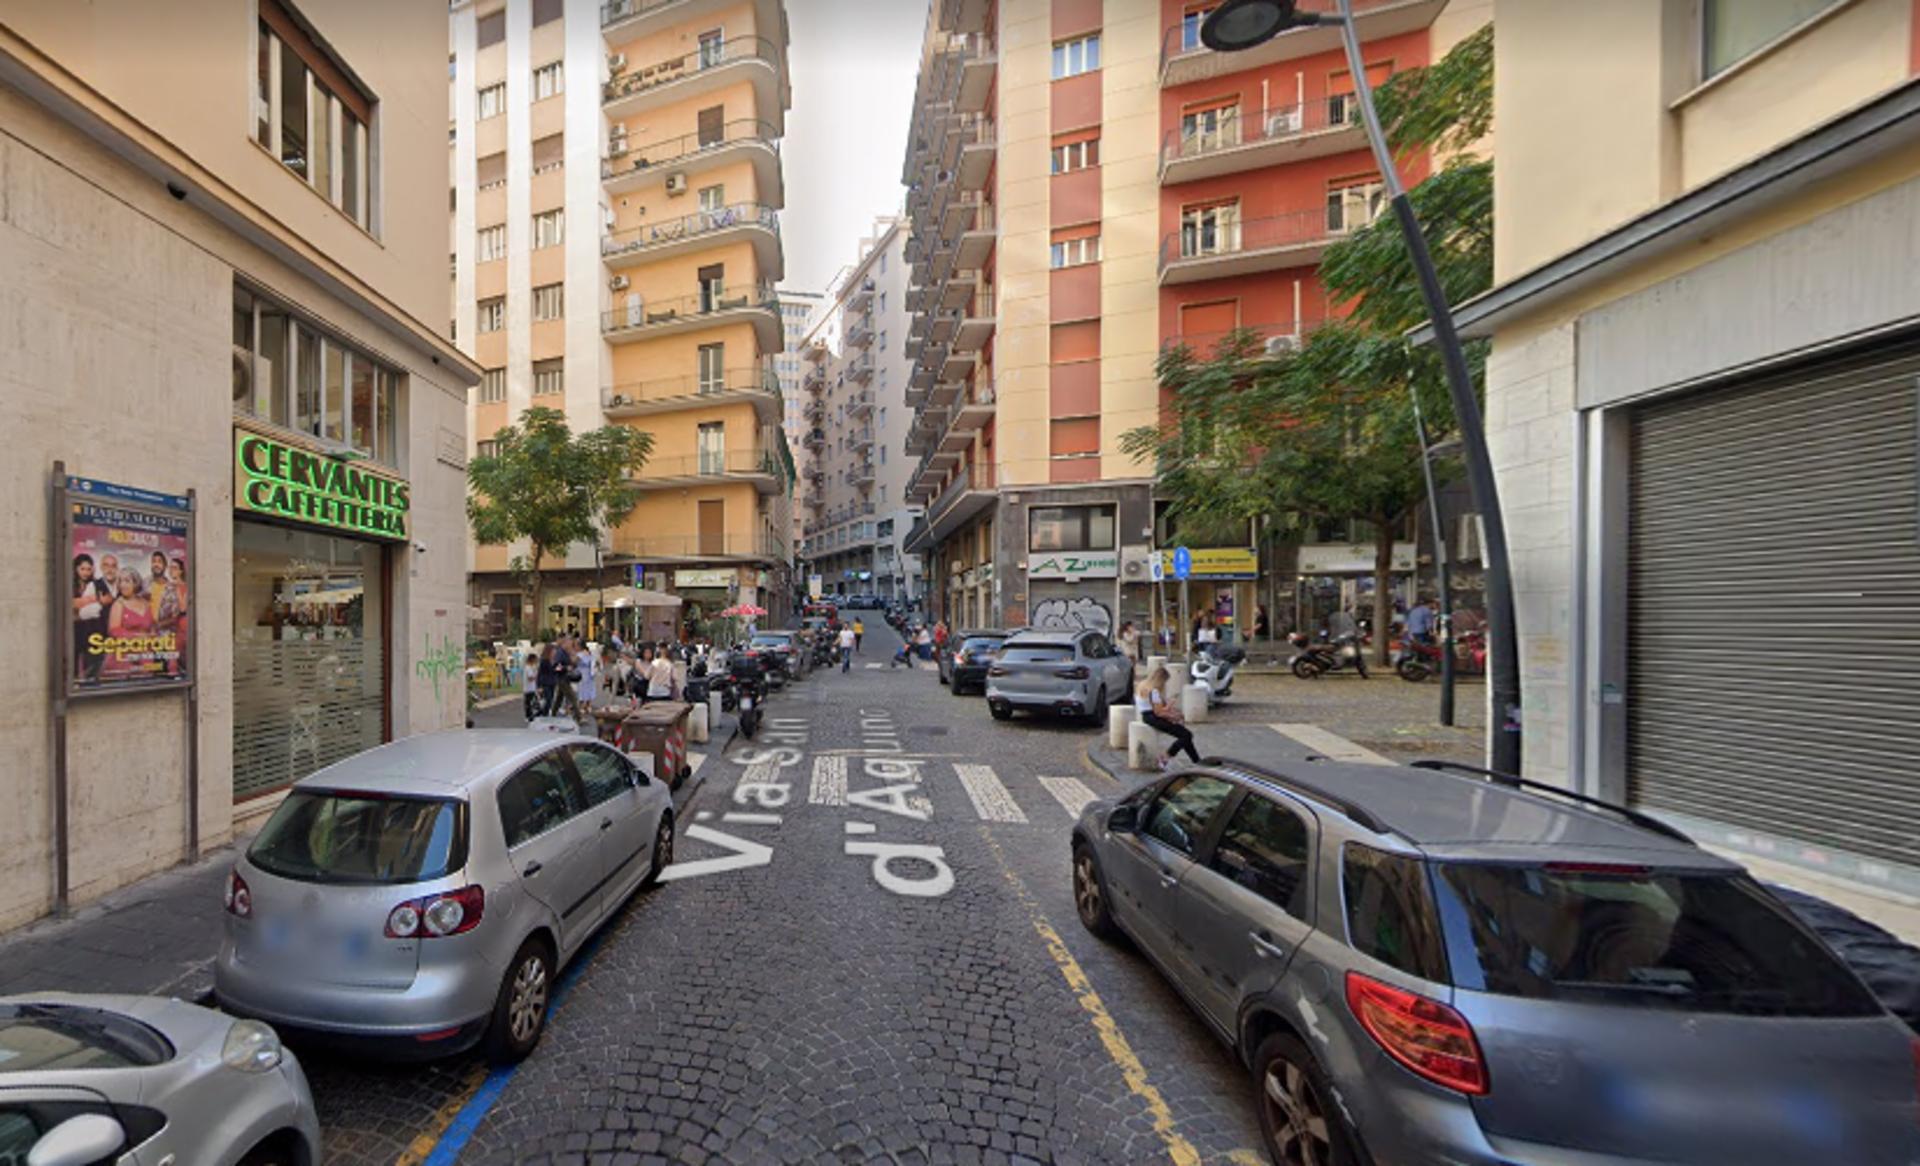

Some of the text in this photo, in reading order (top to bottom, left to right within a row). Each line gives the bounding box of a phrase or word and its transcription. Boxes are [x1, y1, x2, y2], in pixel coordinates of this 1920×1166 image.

[239, 435, 410, 512] CERVANTES
[244, 479, 406, 538] CAFFETTERIA
[88, 632, 176, 662] Separati
